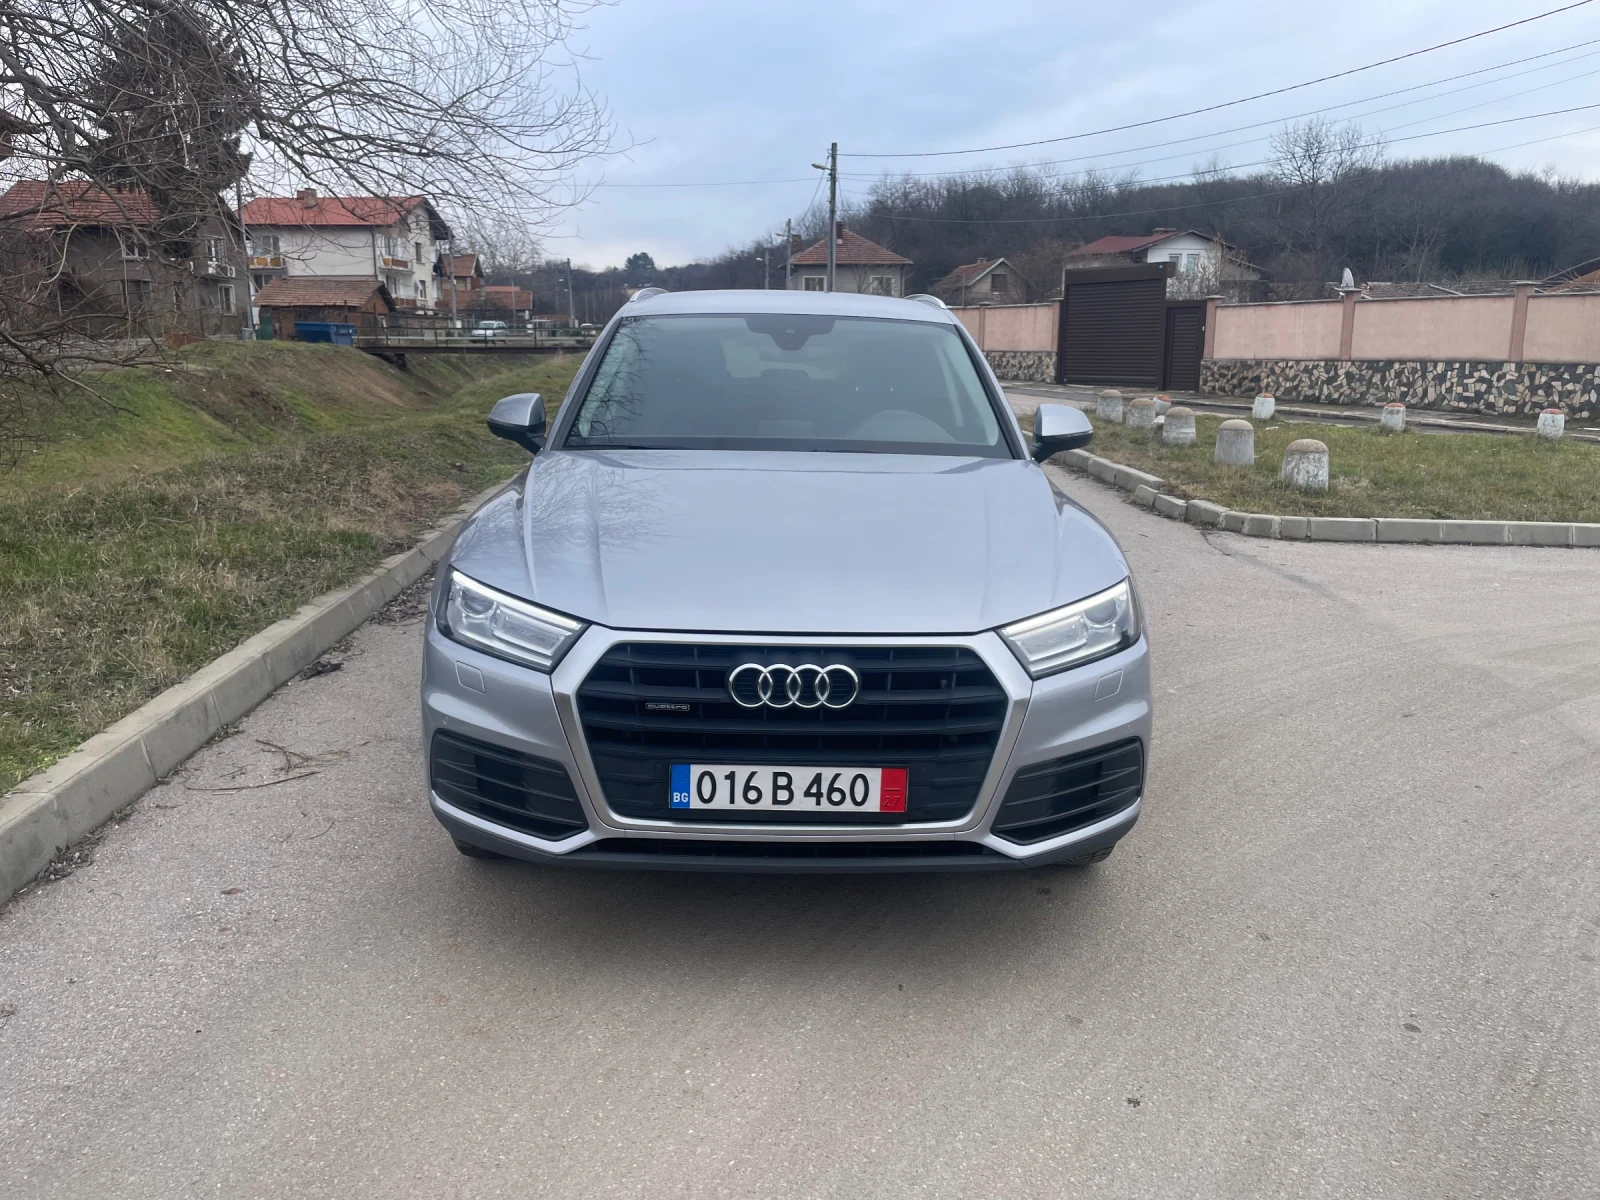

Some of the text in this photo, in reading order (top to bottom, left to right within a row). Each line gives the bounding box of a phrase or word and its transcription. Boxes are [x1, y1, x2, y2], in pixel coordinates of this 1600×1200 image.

[696, 770, 870, 807] 016 B 460
[673, 792, 689, 803] BG
[883, 795, 901, 808] 27
